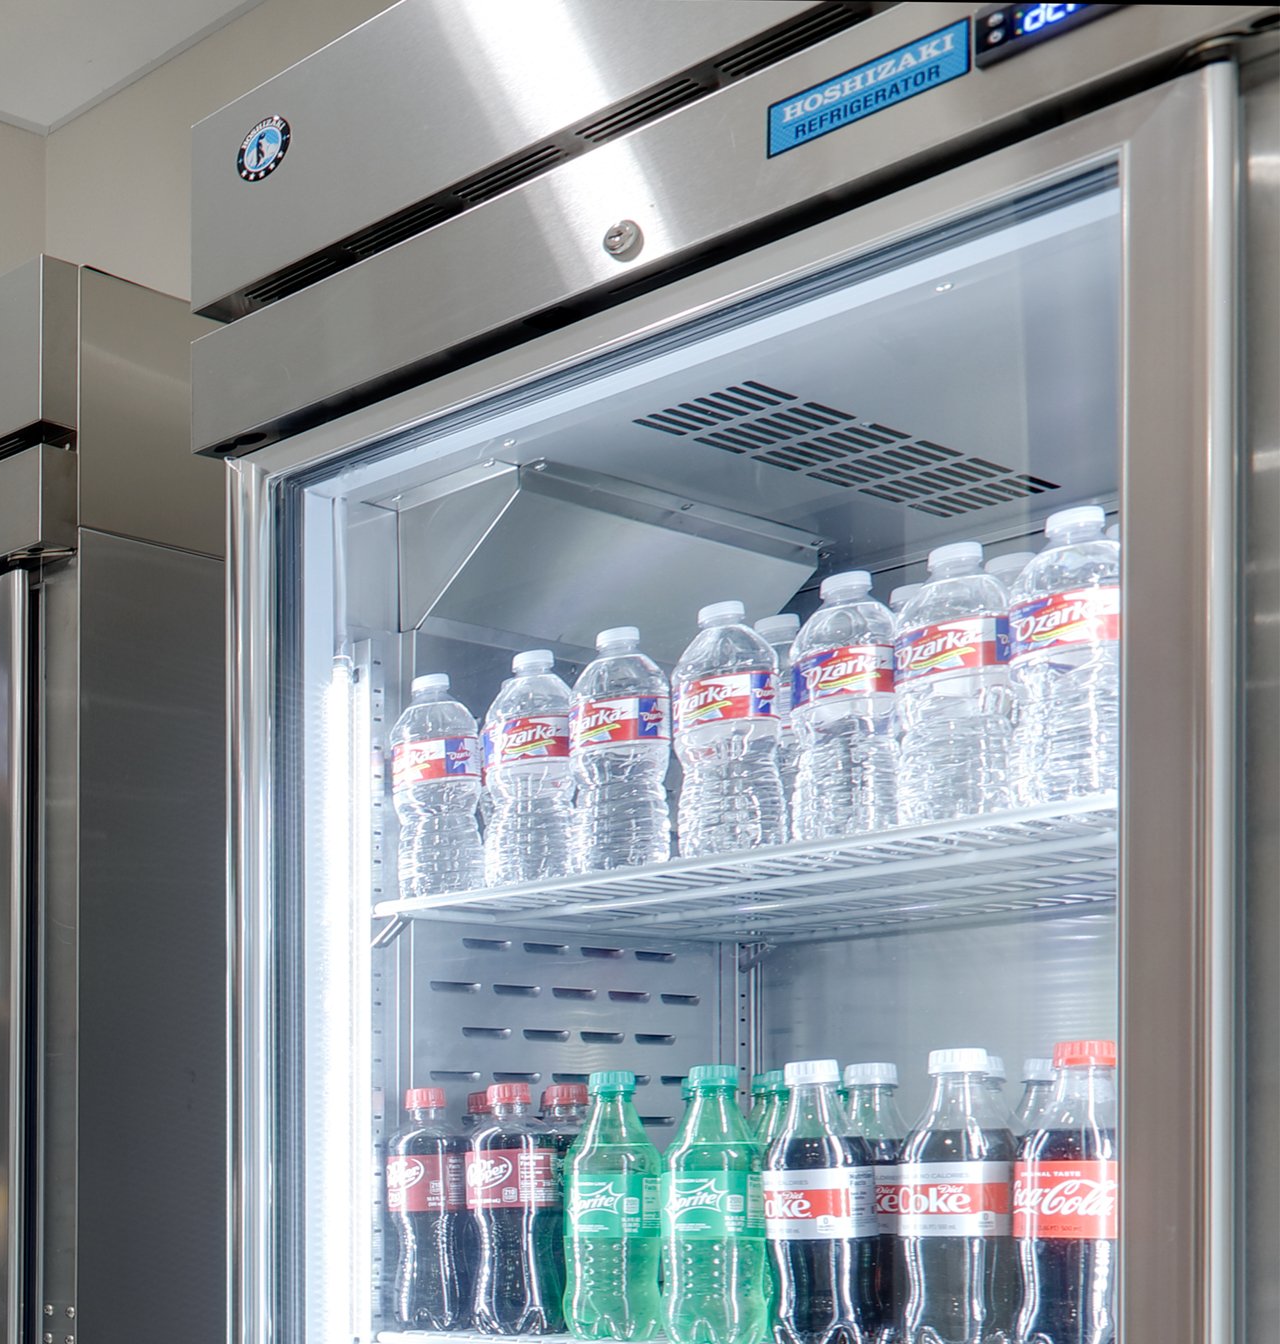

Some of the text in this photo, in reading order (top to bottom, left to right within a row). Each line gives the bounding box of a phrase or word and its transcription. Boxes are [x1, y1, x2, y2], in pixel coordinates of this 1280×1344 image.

[783, 34, 954, 122] HOSHIZAKI
[794, 65, 940, 140] REFRIGERATOR
[895, 631, 977, 669] Ozarka
[802, 655, 881, 688] Ozarka
[670, 1192, 717, 1209] Sprite
[899, 1186, 971, 1214] Coke
[938, 1185, 963, 1194] Diet
[1014, 1179, 1118, 1216] Coca-Cola
